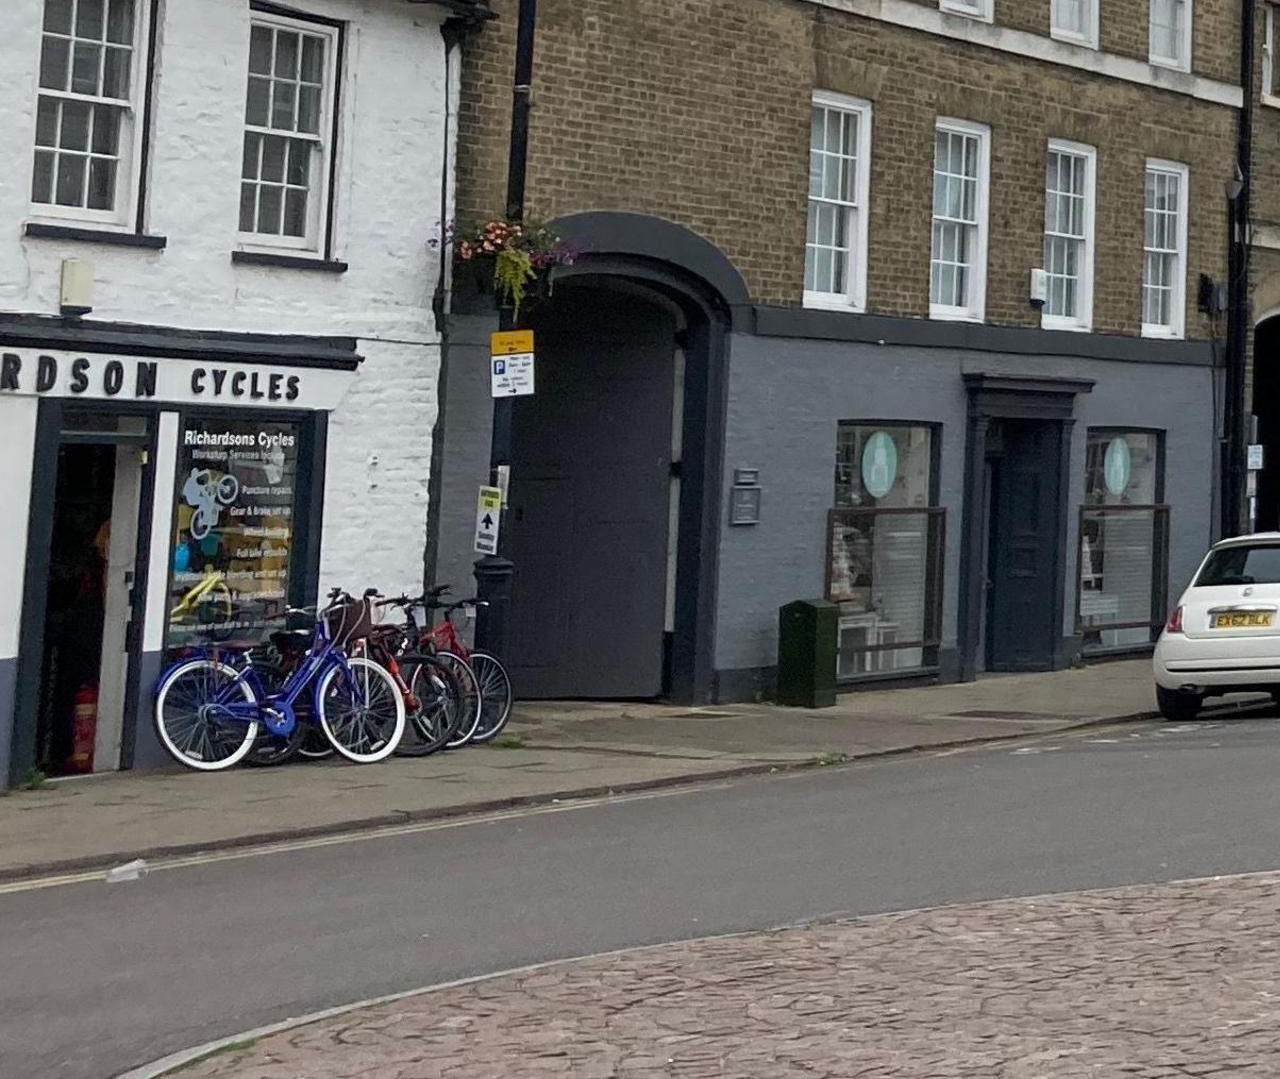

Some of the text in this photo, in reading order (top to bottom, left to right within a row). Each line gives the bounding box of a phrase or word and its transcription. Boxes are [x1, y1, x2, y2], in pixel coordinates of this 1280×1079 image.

[191, 368, 300, 401] CYCLES
[184, 430, 295, 448] Richardsons Cycles
